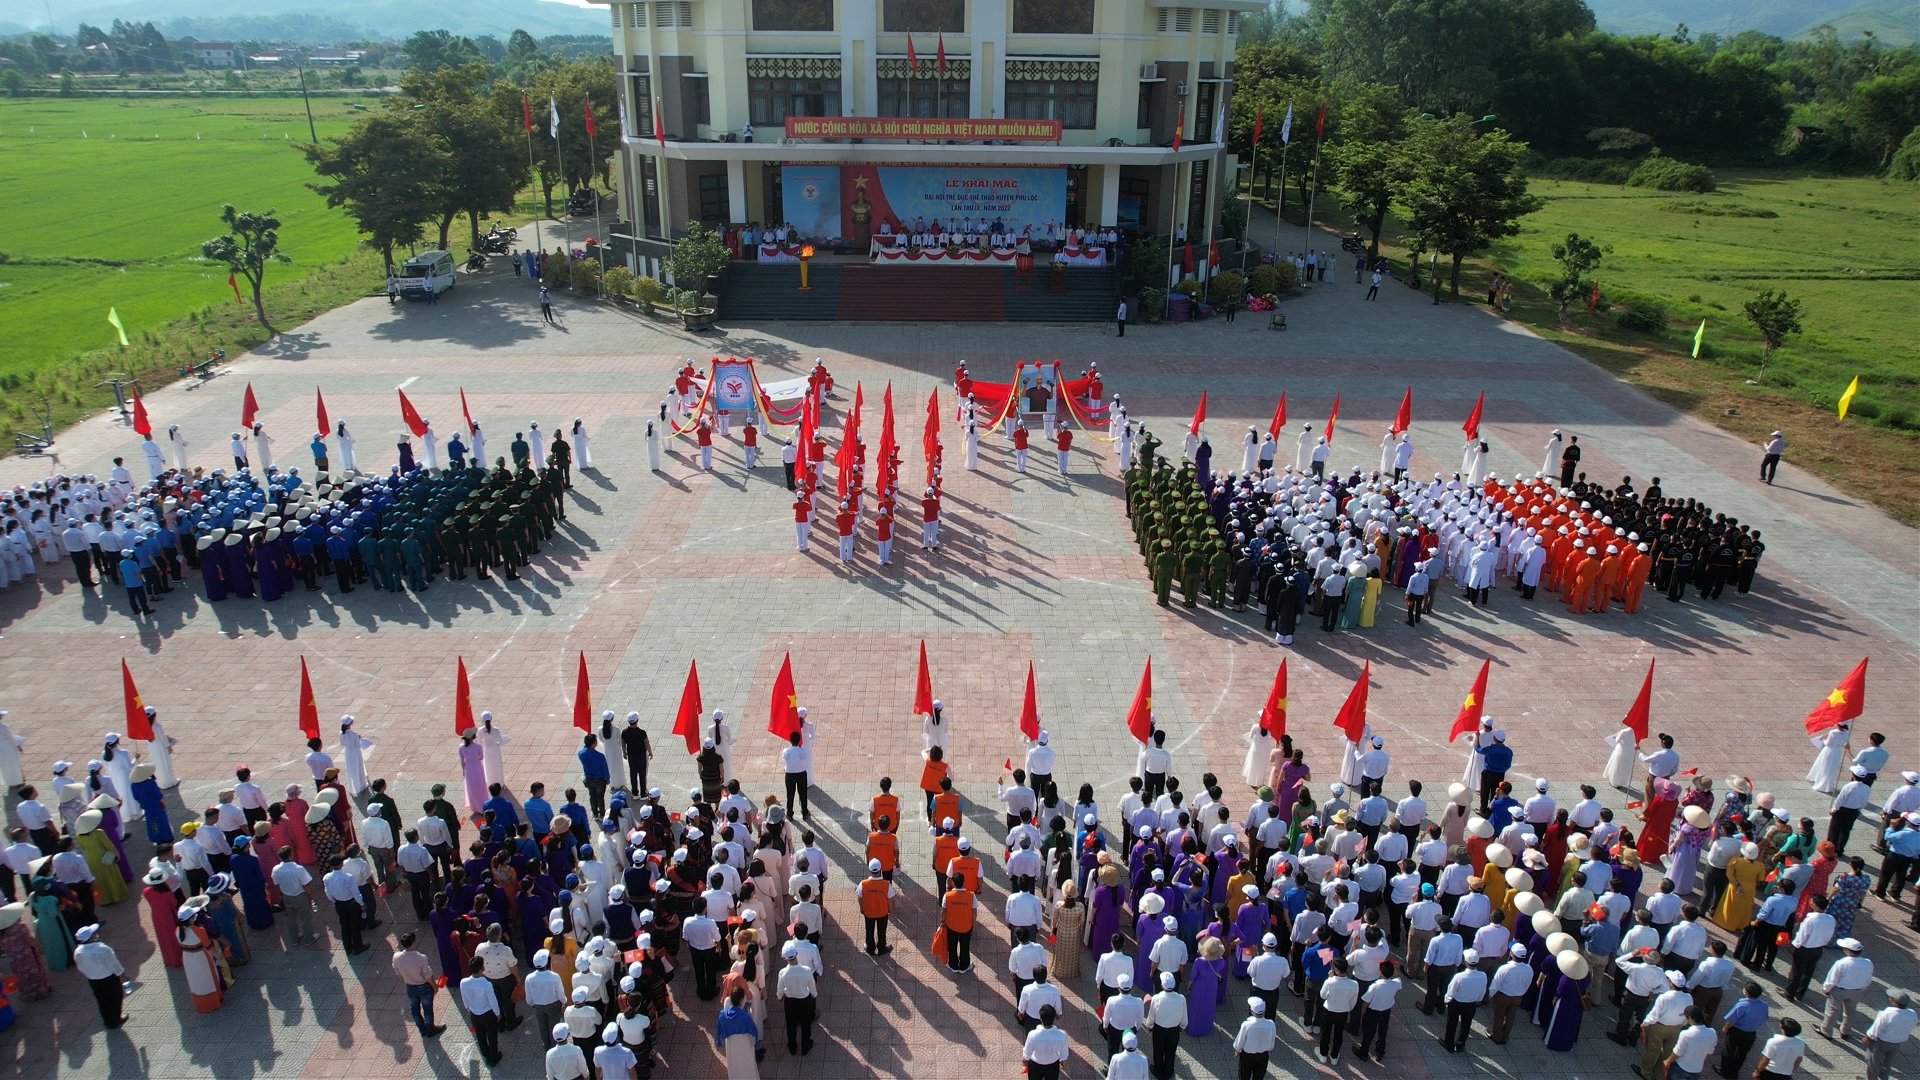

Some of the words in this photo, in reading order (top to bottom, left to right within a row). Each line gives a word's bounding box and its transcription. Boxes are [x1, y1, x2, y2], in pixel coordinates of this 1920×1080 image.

[794, 121, 819, 134] NƯỚC
[822, 121, 847, 136] CỘNG
[849, 121, 868, 134] HÒA
[870, 122, 882, 134] XÃ
[885, 121, 900, 136] HỘI
[902, 120, 921, 135] CHỦ
[923, 122, 951, 135] NGHĨA
[953, 122, 973, 137] VIỆT
[975, 124, 996, 136] NAM
[999, 123, 1026, 136] MUÔN
[1028, 123, 1053, 137] NĂM!
[962, 180, 989, 188] KHAI
